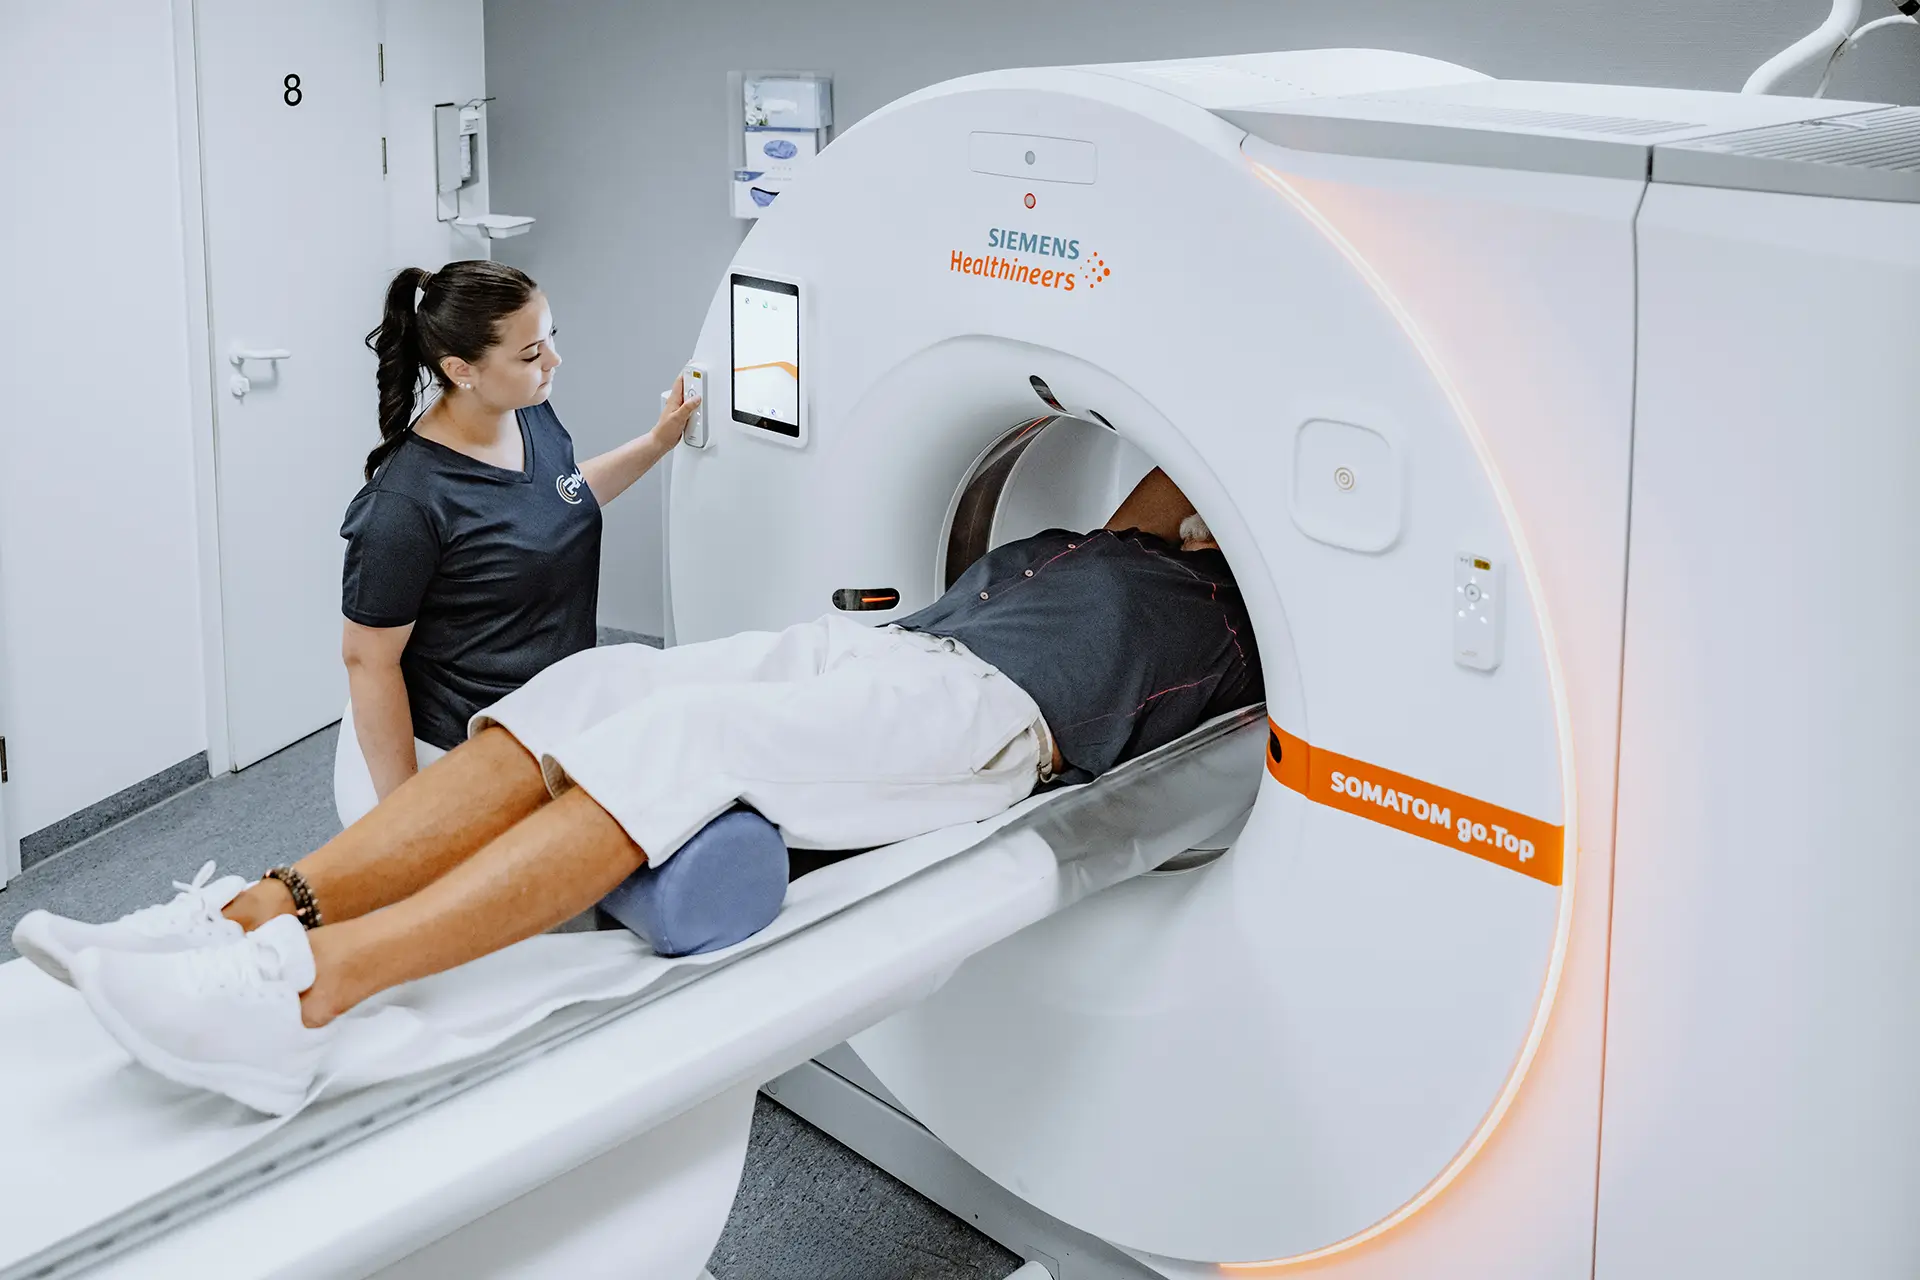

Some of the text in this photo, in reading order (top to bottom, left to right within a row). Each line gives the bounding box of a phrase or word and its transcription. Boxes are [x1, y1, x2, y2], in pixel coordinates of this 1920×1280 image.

[283, 73, 302, 106] 8
[988, 228, 1080, 260] SIEMENS
[950, 250, 1076, 291] Healthineers
[1330, 771, 1535, 862] SOMATOM go.Top
